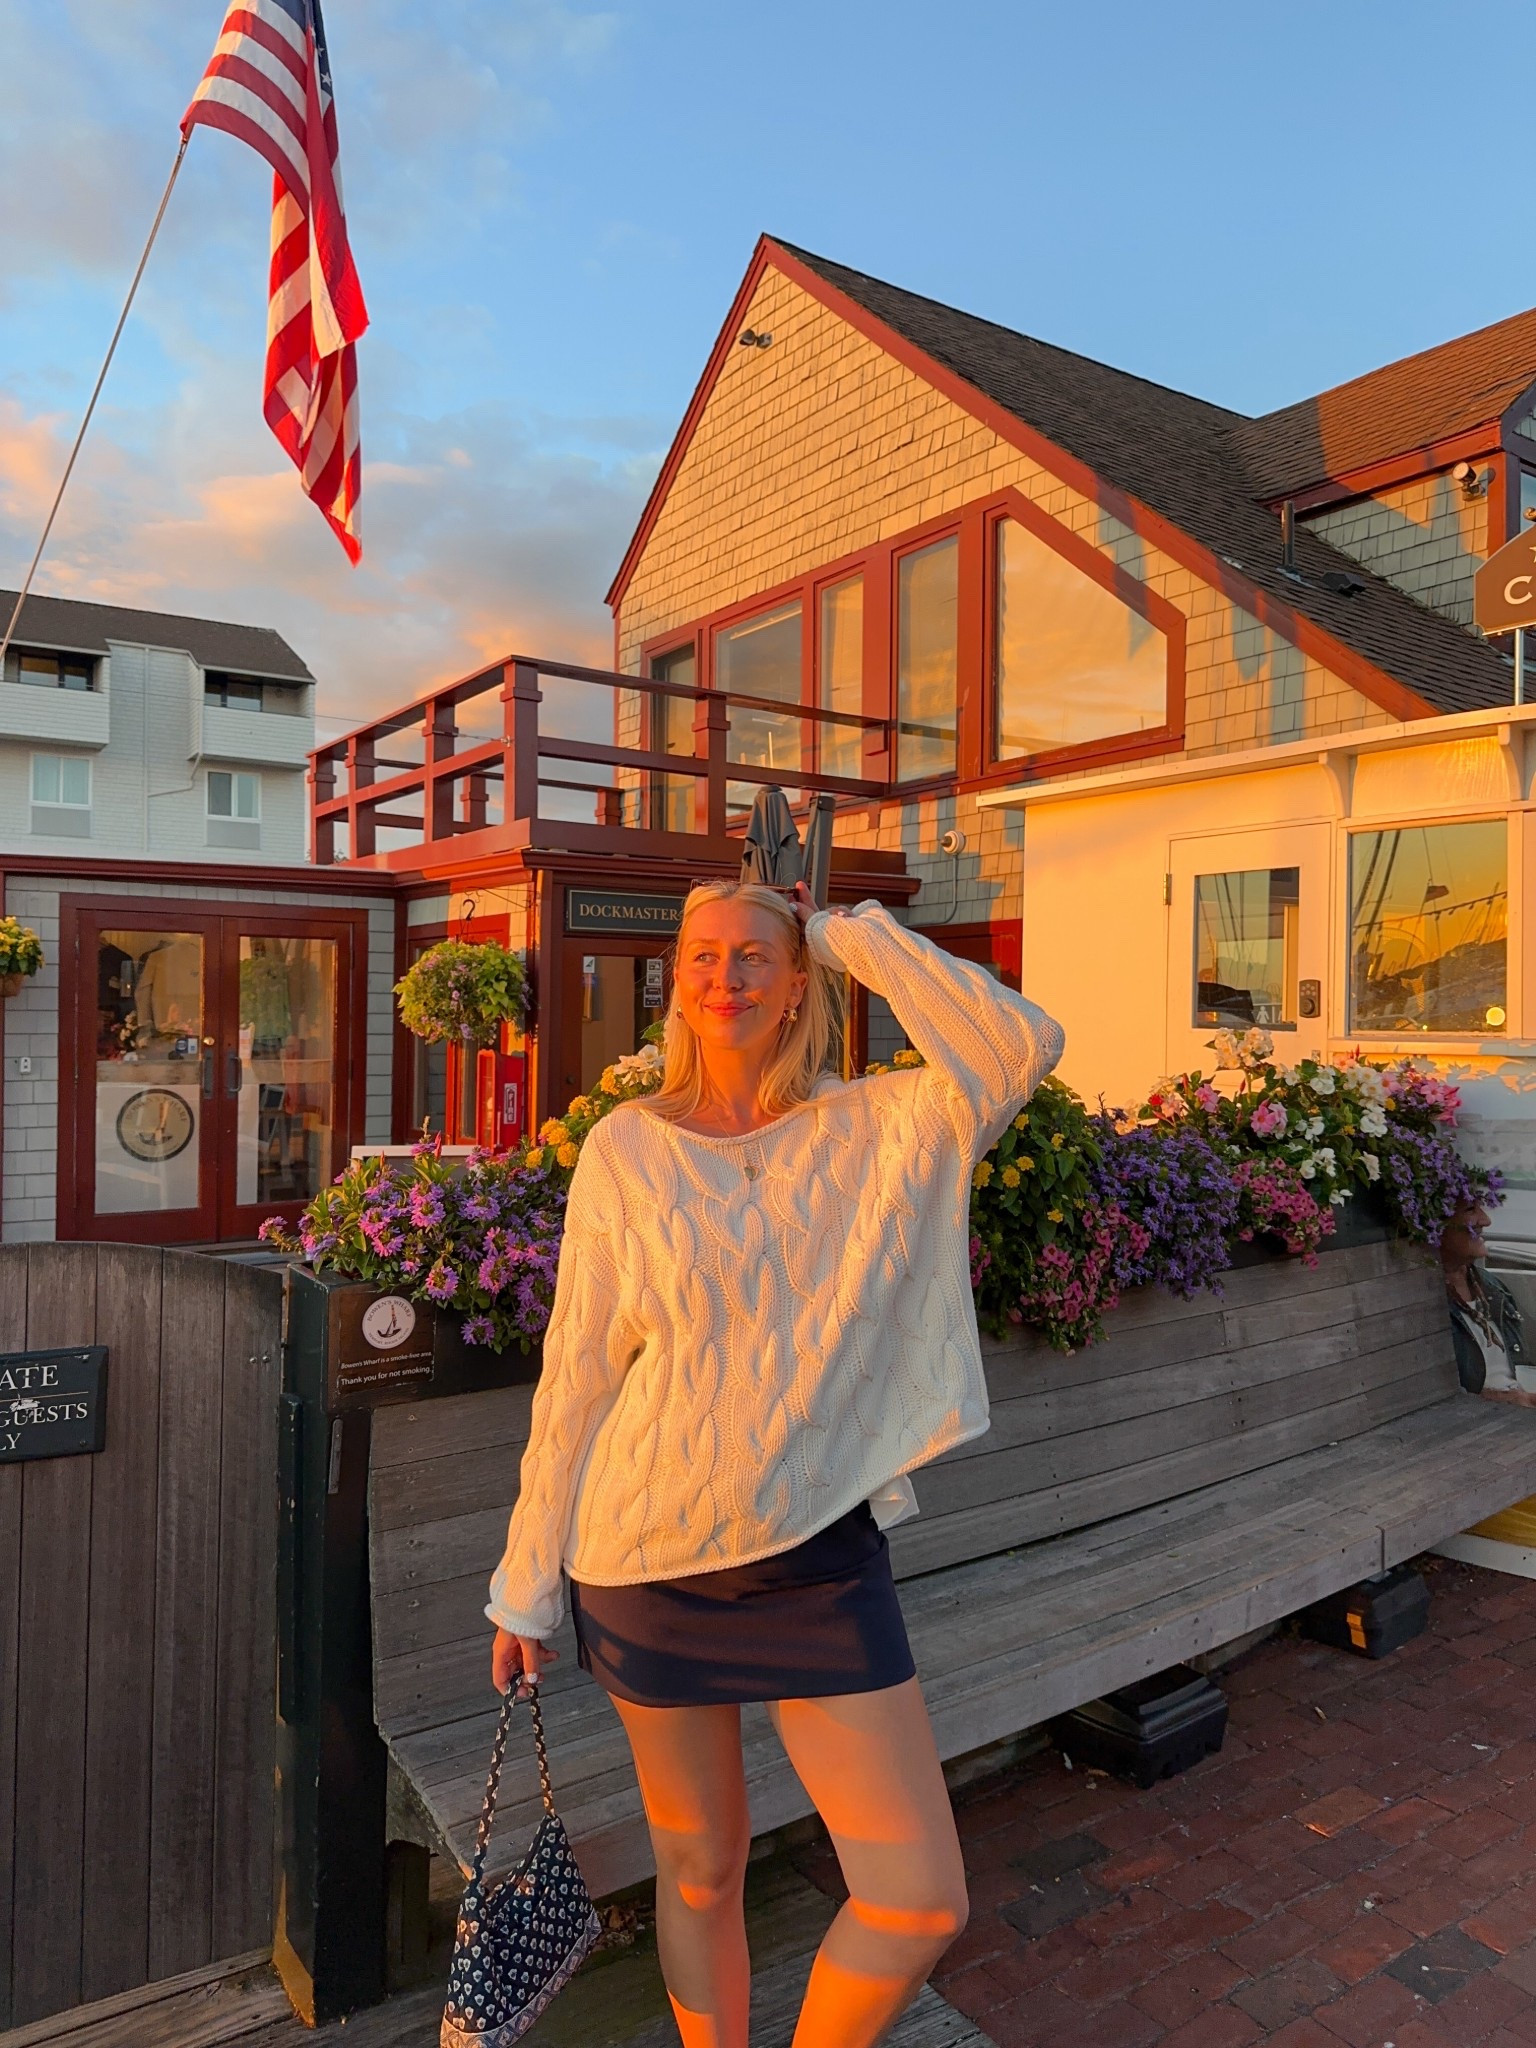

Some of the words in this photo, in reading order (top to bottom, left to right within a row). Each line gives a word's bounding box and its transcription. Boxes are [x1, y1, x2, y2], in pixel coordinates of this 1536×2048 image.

[363, 1357, 380, 1366] Wharf
[341, 1376, 363, 1386] Thank
[363, 1373, 377, 1383] you
[377, 1371, 388, 1380] for
[388, 1370, 401, 1378] not
